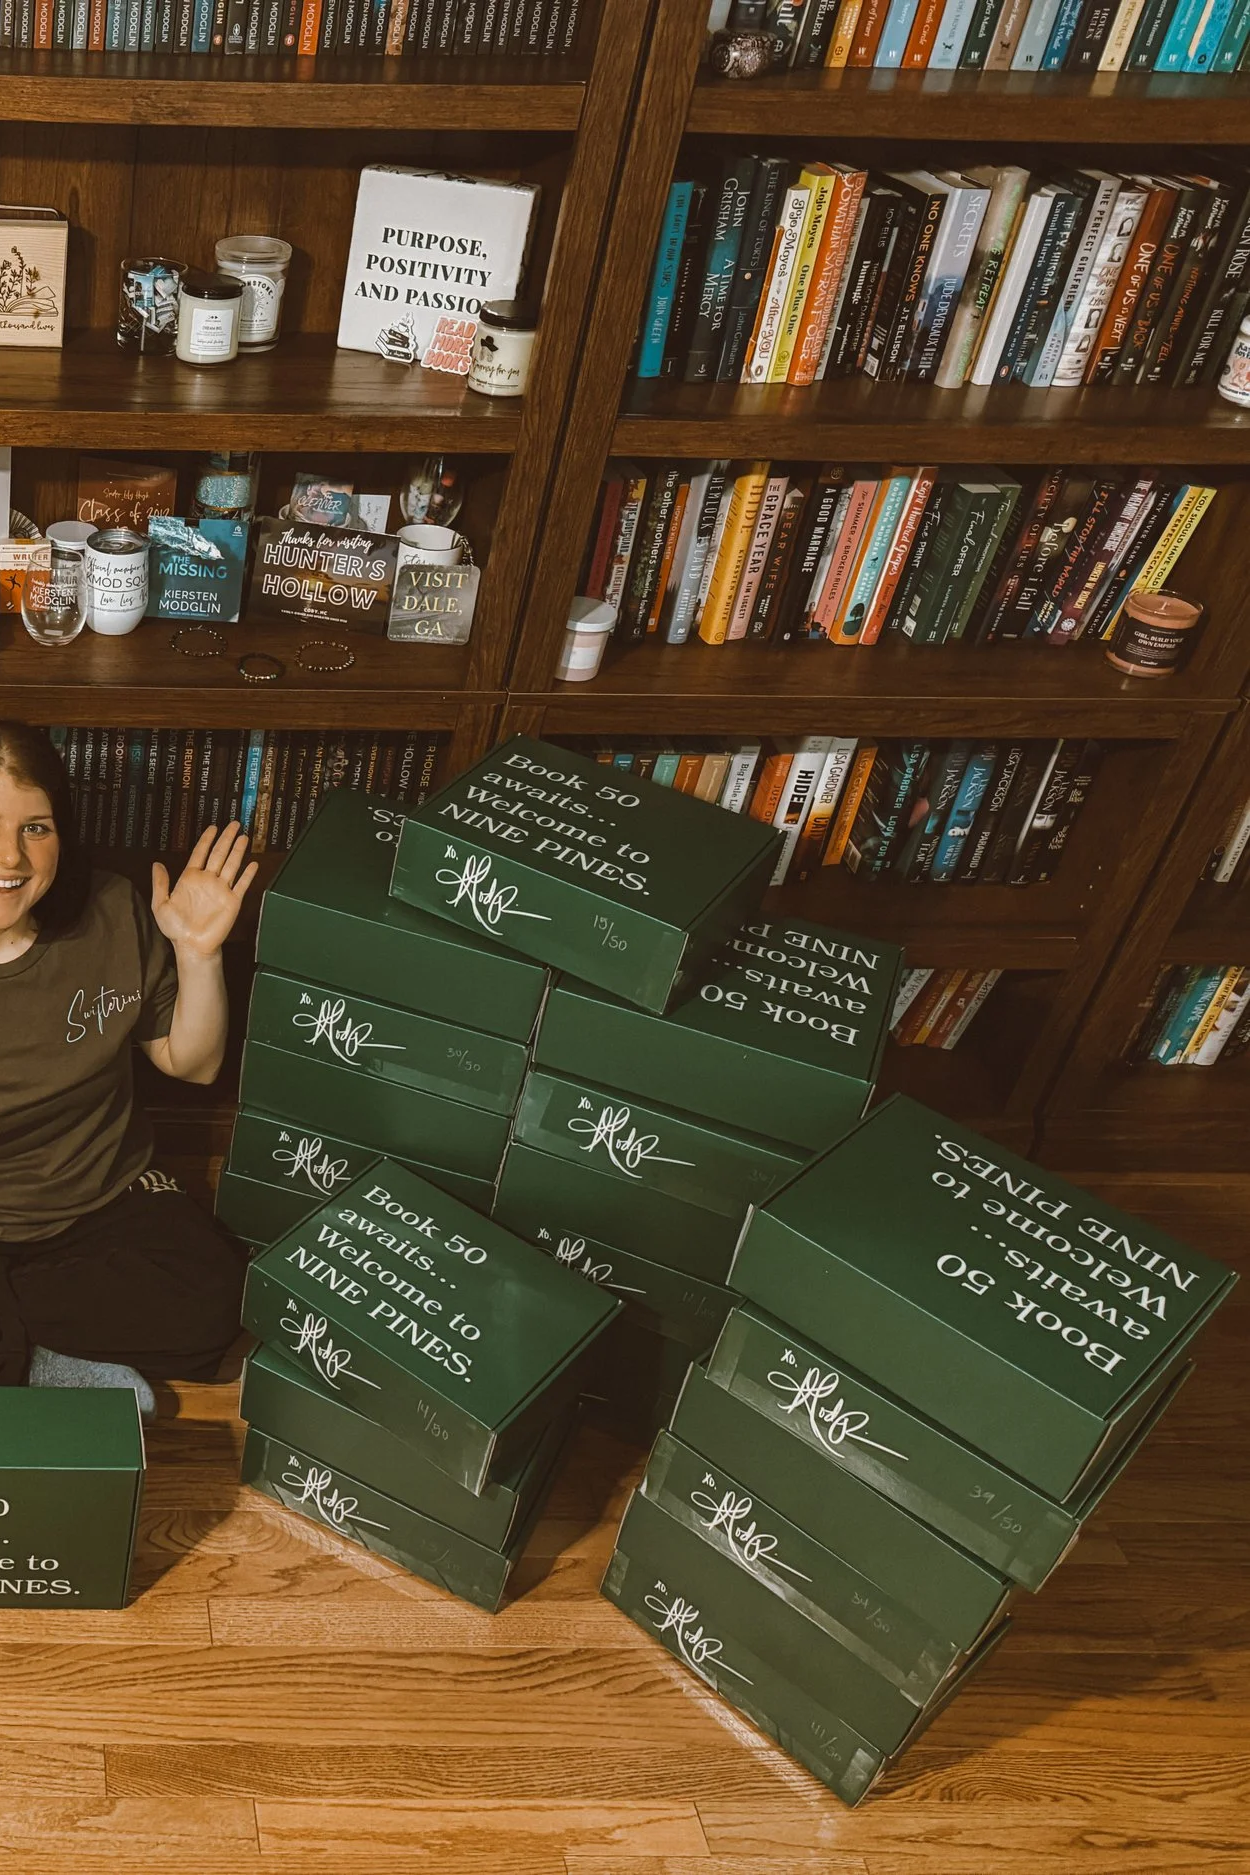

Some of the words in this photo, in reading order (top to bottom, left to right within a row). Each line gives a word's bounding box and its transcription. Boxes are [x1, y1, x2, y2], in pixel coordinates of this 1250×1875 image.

[301, 2, 317, 52] MODGLIN
[715, 177, 739, 242] GRISHAM
[732, 190, 750, 228] JOHN
[928, 200, 941, 221] NO
[382, 227, 488, 260] PURPOSE,
[919, 225, 934, 252] ONE
[365, 253, 493, 287] POSITIVITY
[905, 255, 926, 302] KNOWS
[355, 281, 399, 302] AND
[404, 288, 492, 315] PASSIO
[0, 320, 36, 331] thousand
[37, 320, 56, 331] lives
[436, 317, 477, 338] READ
[1206, 309, 1224, 330] KILL
[431, 334, 472, 355] MORE
[1198, 329, 1214, 350] FOR
[422, 349, 471, 372] BOOKS
[1191, 352, 1207, 366] ME
[79, 499, 125, 522] Class
[658, 491, 672, 526] other
[756, 495, 779, 540] GRACE
[278, 527, 316, 547] Thanks
[316, 533, 335, 550] for
[336, 536, 374, 554] visiting
[649, 527, 666, 565] mothers
[159, 562, 227, 579] MISSING
[171, 555, 191, 565] THE
[263, 543, 387, 581] HUNTER'S
[747, 542, 766, 575] YEAR
[950, 545, 970, 577] OFFER
[32, 586, 74, 598] KIERSTEN
[87, 573, 123, 589] KMOD
[164, 589, 218, 601] KIERSTEN
[262, 573, 377, 611] HOLLOW
[409, 571, 469, 589] VISIT
[30, 594, 76, 606] MODGLIN
[159, 600, 221, 613] MODGLIN
[402, 595, 463, 616] DALE,
[415, 619, 443, 636] GA
[181, 747, 194, 789] REUNION
[502, 753, 589, 791] Book
[596, 786, 640, 808] 50
[483, 770, 617, 827] awaits...
[789, 769, 815, 806] HIDE
[465, 785, 607, 852] Welcome
[614, 842, 650, 865] to
[438, 803, 529, 845] NINE
[532, 840, 650, 895] PINES.
[726, 938, 873, 996] Welcom
[785, 931, 880, 971] NINE
[712, 958, 865, 1018] awaits...
[700, 984, 748, 1012] 50
[760, 1000, 860, 1046] Book
[931, 1170, 971, 1200] to
[934, 1134, 1072, 1220] PINES.
[361, 1185, 440, 1239] Book
[445, 1235, 487, 1265] 50
[338, 1208, 456, 1289] awaits...
[981, 1197, 1169, 1321] Welcome
[1077, 1216, 1201, 1293] NINE
[317, 1224, 443, 1316] Welcome
[448, 1313, 481, 1341] to
[936, 1252, 997, 1296] 50
[970, 1225, 1152, 1341] awaits...
[285, 1246, 369, 1306] NINE
[366, 1300, 472, 1382] PINES.
[1003, 1289, 1127, 1377] Book
[26, 1555, 59, 1571] to
